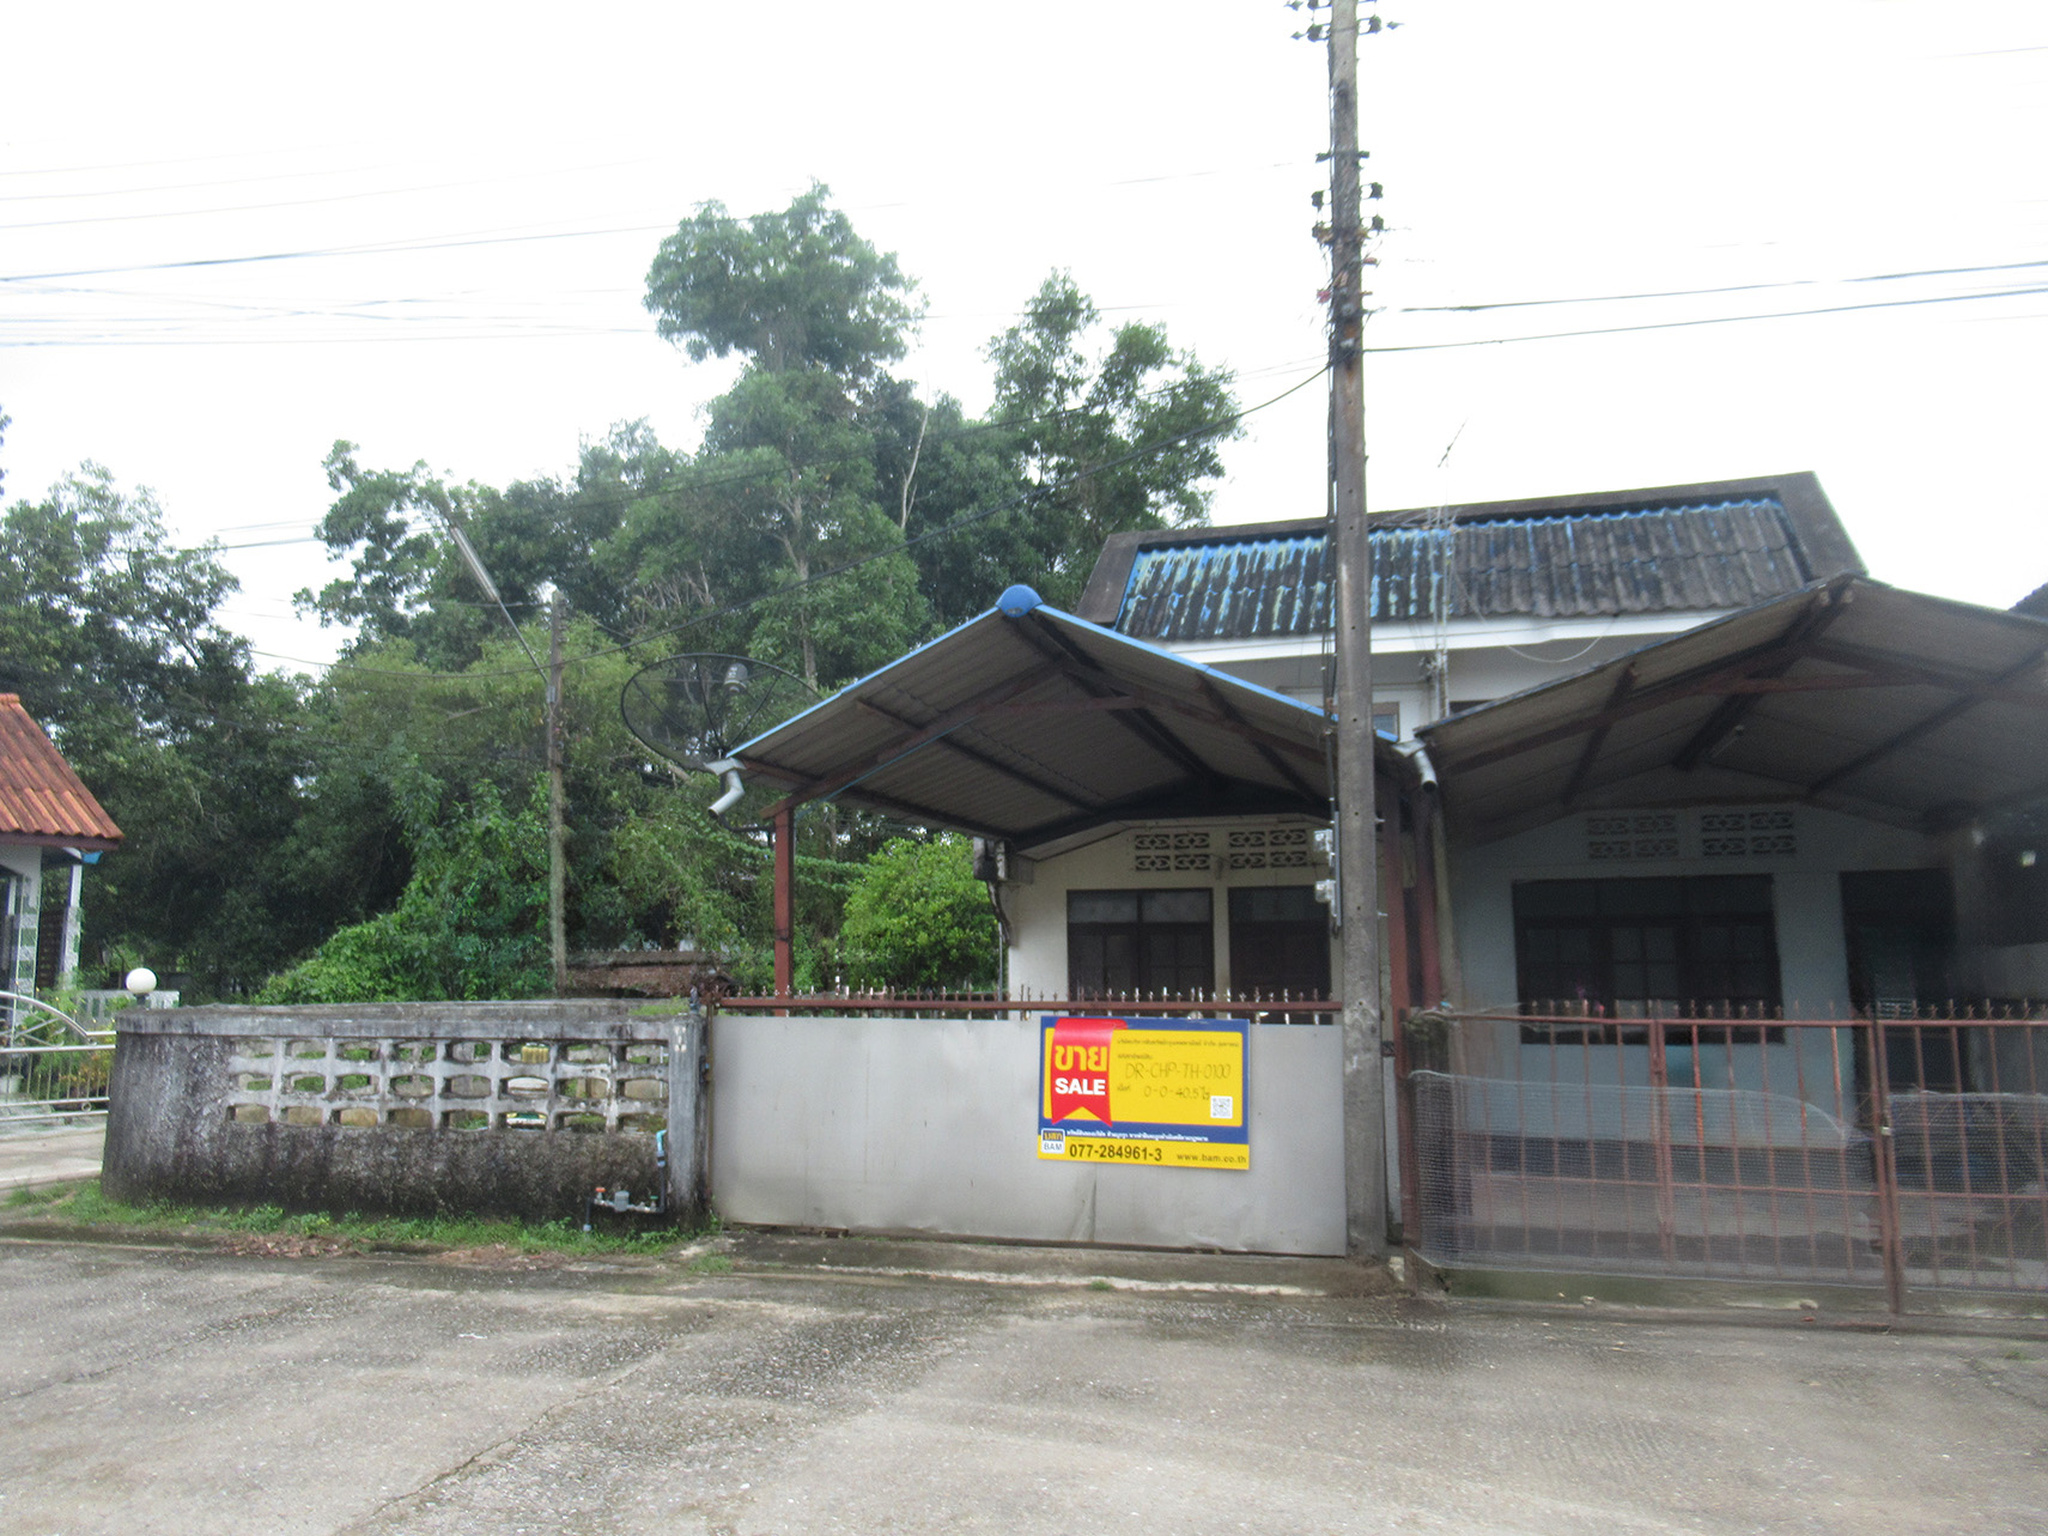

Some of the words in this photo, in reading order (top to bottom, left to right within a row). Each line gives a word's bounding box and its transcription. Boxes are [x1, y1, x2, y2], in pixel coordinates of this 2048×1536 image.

[1054, 1045, 1108, 1072] ขาย
[1054, 1077, 1106, 1096] SALE
[1043, 1142, 1063, 1151] BAM
[1069, 1143, 1163, 1162] 077-284961-3
[1176, 1152, 1247, 1164] www.bam.co.th
